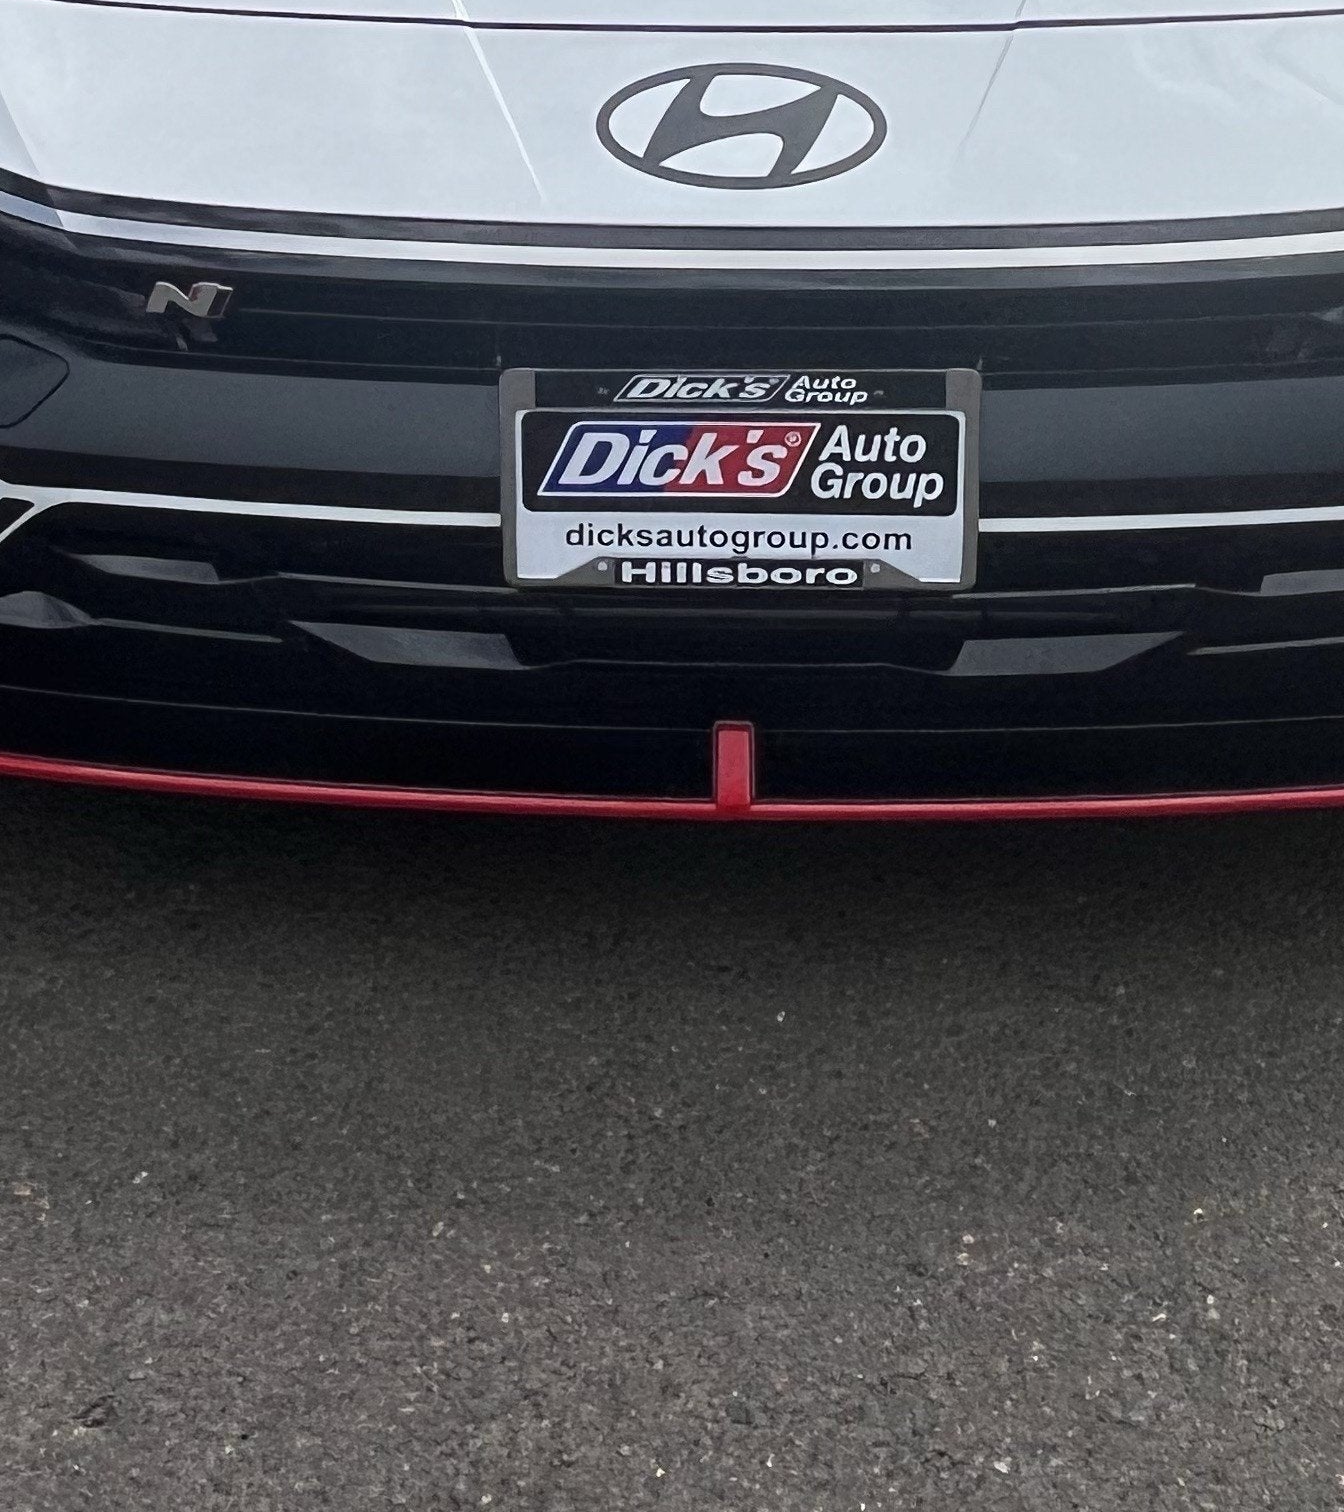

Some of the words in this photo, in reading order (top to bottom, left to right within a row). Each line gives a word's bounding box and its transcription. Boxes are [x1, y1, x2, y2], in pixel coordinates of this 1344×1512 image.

[626, 374, 772, 399] Dick's
[793, 374, 857, 390] Auto
[784, 389, 869, 406] Group
[557, 428, 788, 486] Dick's
[818, 424, 927, 464] Auto
[810, 462, 945, 509] Group
[565, 523, 913, 555] dicksautogroup.com
[621, 561, 859, 586] Hillsboro
